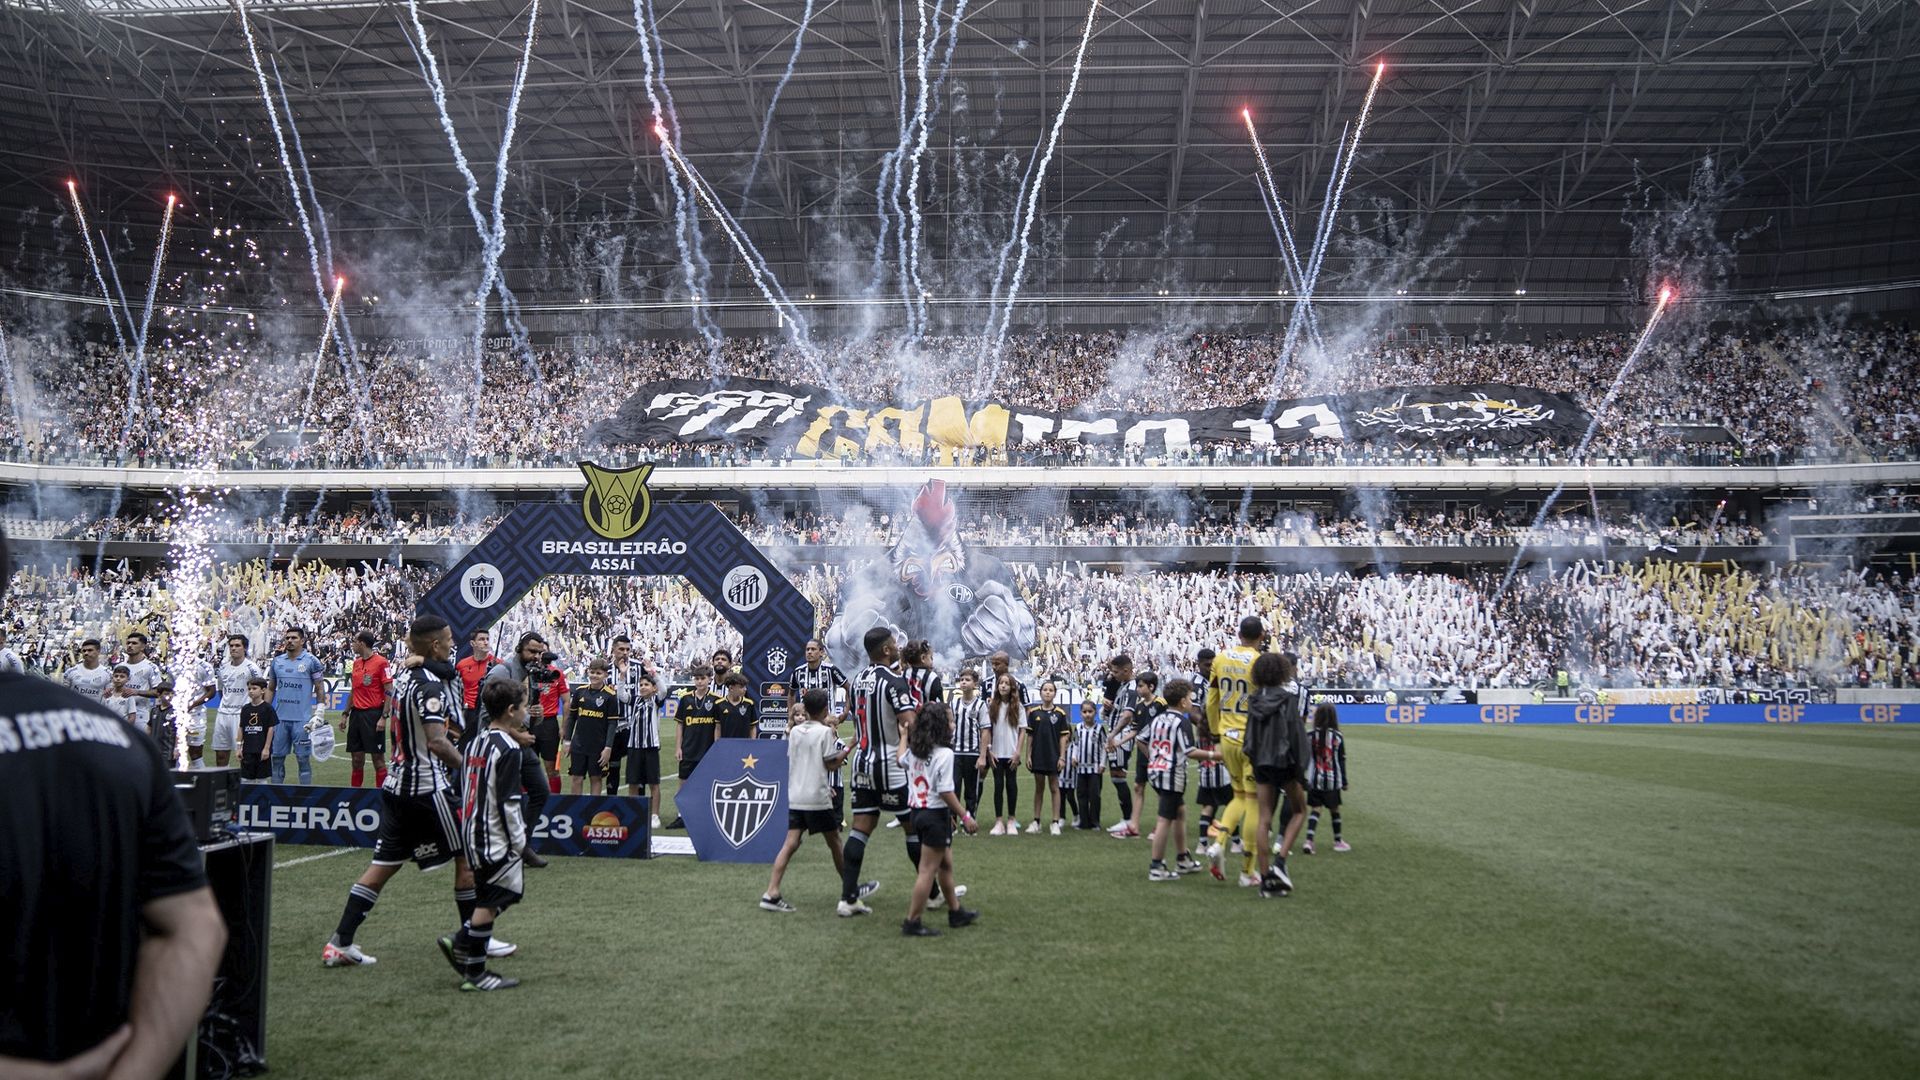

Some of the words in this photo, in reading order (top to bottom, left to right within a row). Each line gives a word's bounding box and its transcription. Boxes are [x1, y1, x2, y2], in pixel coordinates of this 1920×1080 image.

[542, 538, 687, 555] BRASILEIRÃO
[283, 682, 303, 690] blaze
[1219, 676, 1249, 714] 22
[1385, 705, 1426, 723] CBF
[1480, 705, 1521, 723] CBF
[1575, 705, 1616, 723] CBF
[1669, 705, 1710, 723] CBF
[1764, 704, 1805, 723] CBF
[1859, 704, 1901, 723] CBF
[721, 788, 769, 800] CAM
